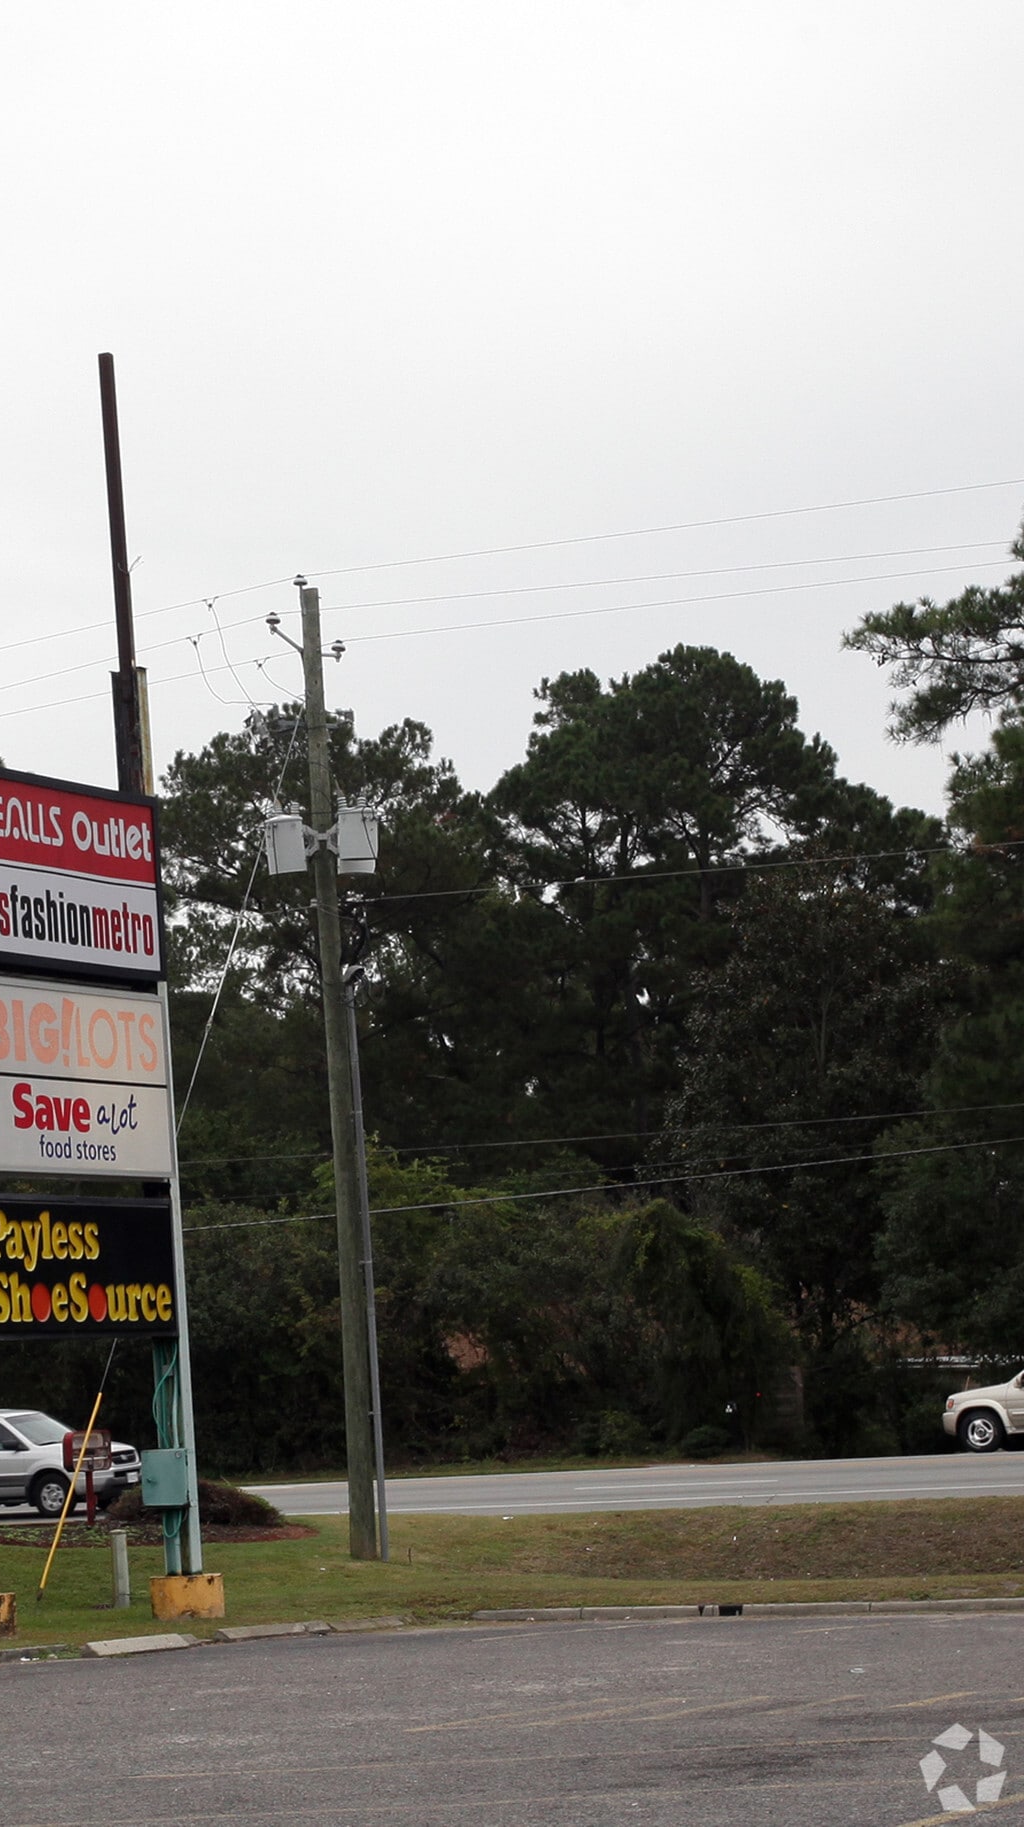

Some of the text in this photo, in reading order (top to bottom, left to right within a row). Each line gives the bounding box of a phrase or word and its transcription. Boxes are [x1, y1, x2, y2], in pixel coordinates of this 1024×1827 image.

[71, 811, 152, 862] Outlet
[12, 1082, 91, 1133] Save
[39, 1134, 117, 1162] food stores
